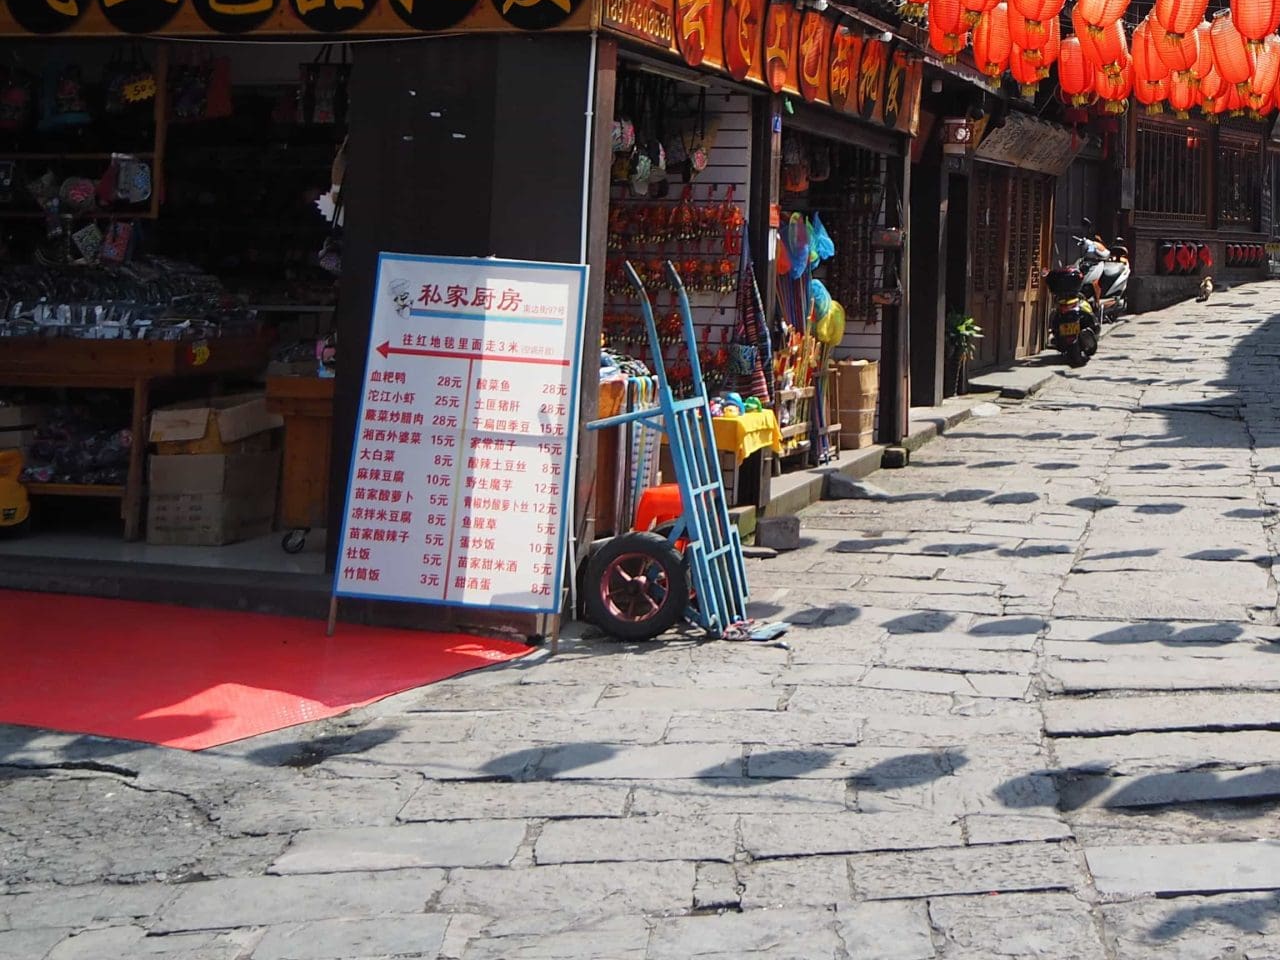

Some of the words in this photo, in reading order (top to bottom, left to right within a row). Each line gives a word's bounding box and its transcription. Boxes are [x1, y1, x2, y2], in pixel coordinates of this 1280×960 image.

[417, 284, 523, 312] 私家厨房
[402, 333, 521, 353] 往红地毯里面走3米
[370, 370, 406, 384] 血粑鸭
[437, 376, 462, 388] 28元
[476, 378, 510, 392] 酸菜鱼
[542, 384, 567, 396] 28元
[368, 389, 415, 404] 沱江小虾
[435, 396, 459, 408] 25元
[474, 398, 520, 412] 土匪猪肝
[540, 404, 566, 416] 28元
[365, 409, 423, 425] 蕨菜炒腊肉
[432, 415, 457, 427] 28元
[362, 428, 422, 445] 湘西外婆菜
[431, 435, 455, 447] 15元
[540, 423, 564, 436] 15元
[470, 436, 517, 452] 家常茄子
[538, 443, 562, 455] 15元
[360, 449, 395, 462] 大白菜
[434, 455, 452, 467] 8元
[467, 456, 527, 472] 酸辣土豆丝
[542, 463, 561, 475] 8元
[356, 468, 404, 483] 麻辣豆腐
[427, 475, 451, 487] 10元
[465, 476, 513, 491] 野生魔芋
[535, 483, 559, 495] 12元
[354, 487, 413, 504] 苗家酸萝卜
[430, 494, 448, 506] 5元
[463, 496, 529, 513] 青椒炒酸萝卜丝
[533, 503, 557, 515] 12元
[352, 507, 412, 524] 凉拌米豆腐
[428, 514, 446, 526] 8元
[461, 516, 497, 530] 鱼腥草
[537, 523, 556, 535] 5元
[349, 527, 409, 543] 苗家酸辣子
[425, 534, 444, 546] 5元
[459, 535, 496, 550] 蛋炒饭
[529, 543, 554, 555] 10元
[347, 547, 371, 561] 社饭
[423, 554, 442, 566] 5元
[457, 556, 518, 573] 苗家甜米酒
[533, 563, 552, 576] 5元
[344, 566, 380, 581] 竹筒饭
[420, 574, 439, 586] 3元
[455, 576, 491, 590] 甜酒蛋
[531, 583, 551, 596] 8元
